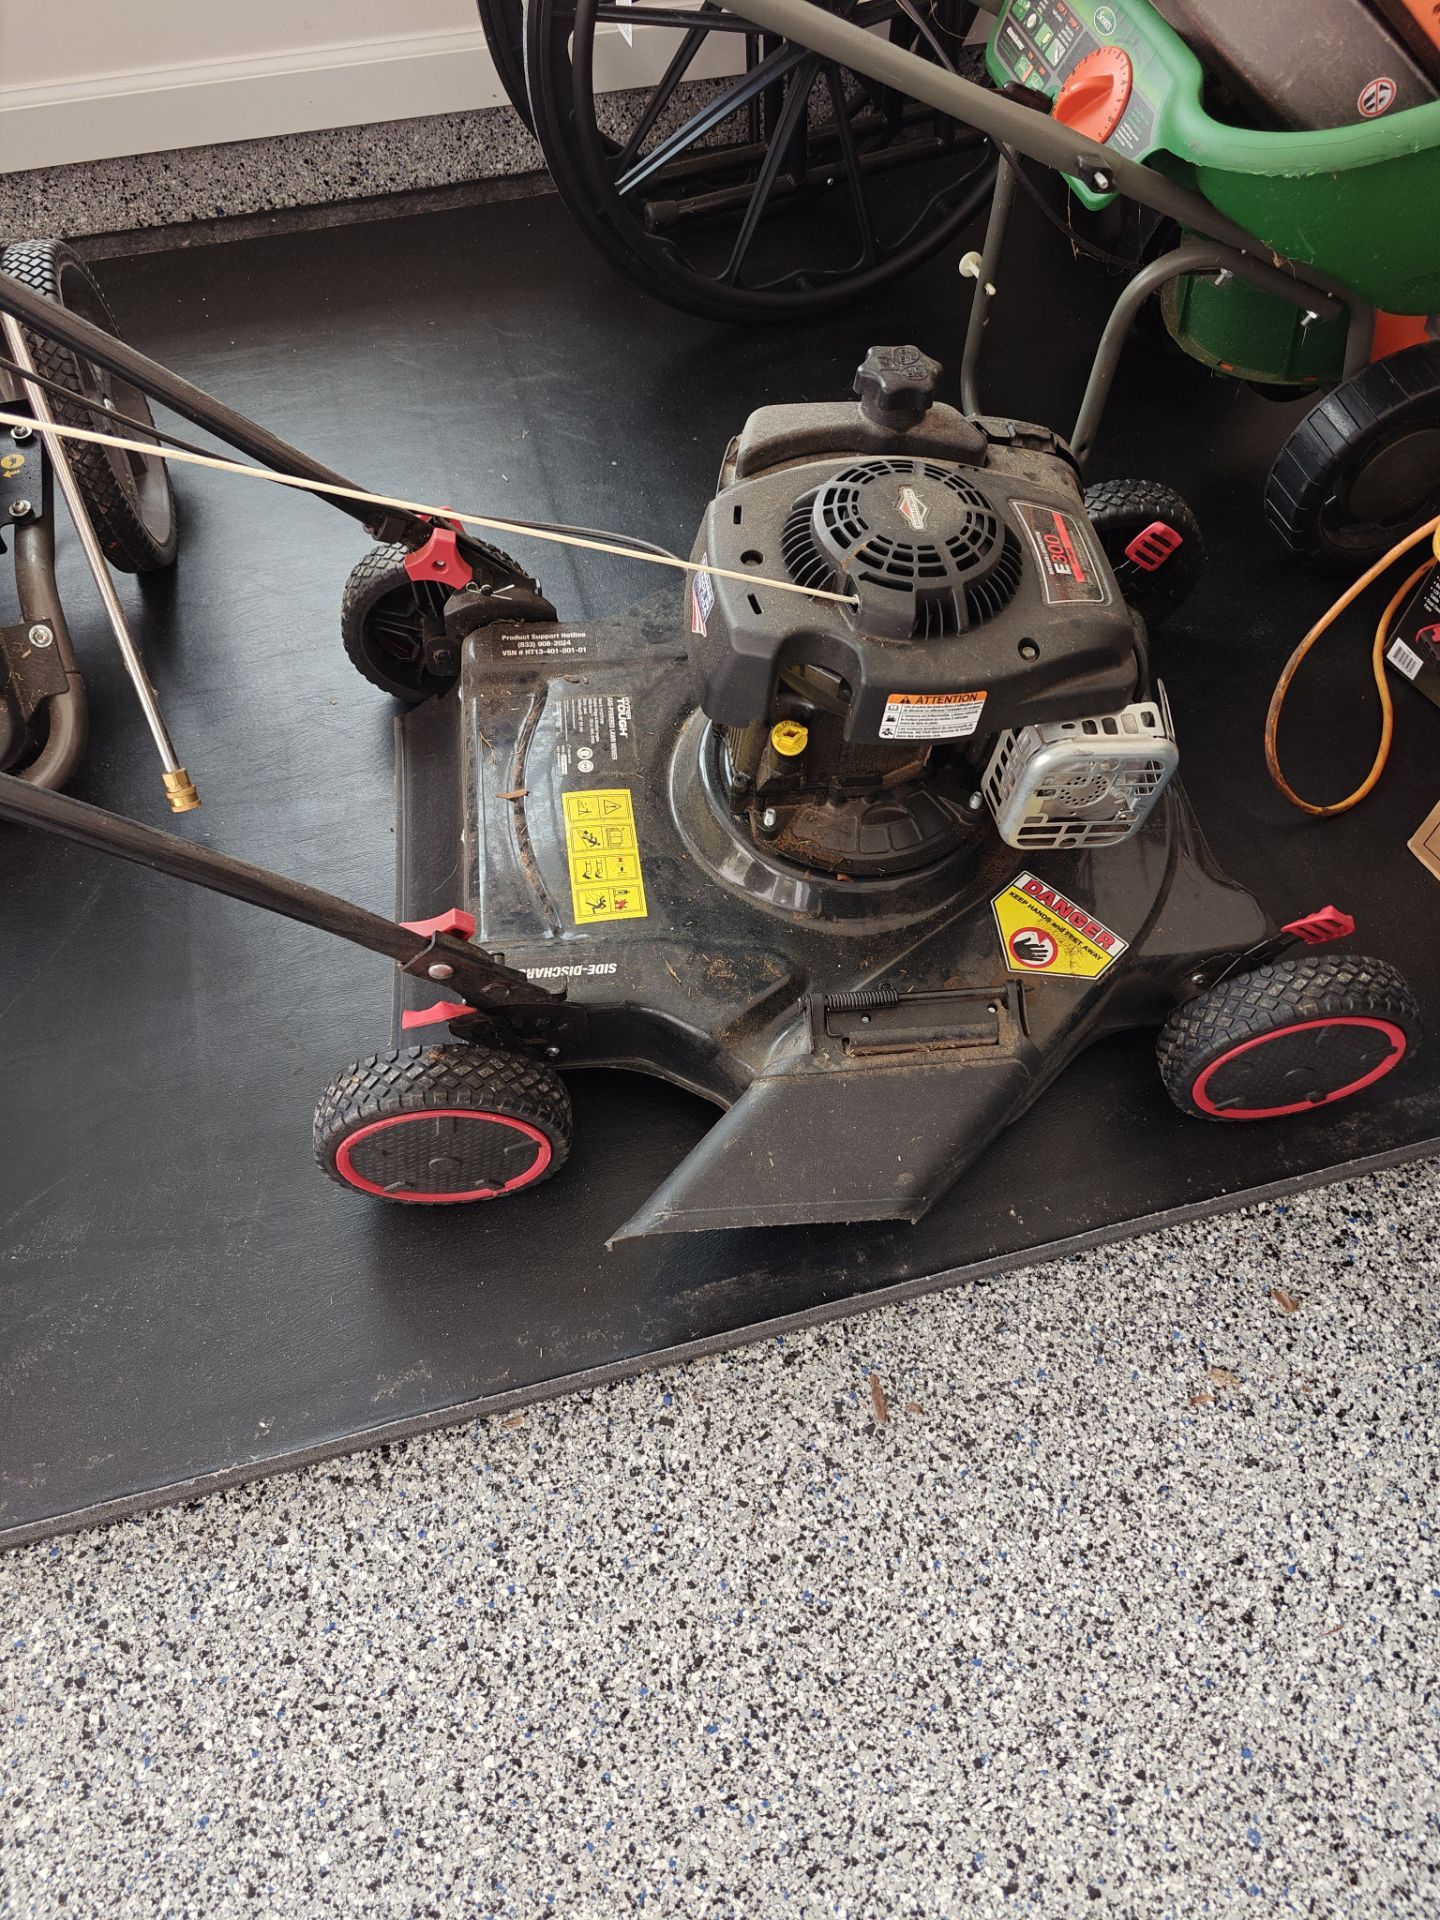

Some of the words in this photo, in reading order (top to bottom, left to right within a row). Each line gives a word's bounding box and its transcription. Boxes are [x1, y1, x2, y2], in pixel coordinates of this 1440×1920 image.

[1097, 10, 1112, 31] Scotts
[1043, 534, 1072, 576] E300
[525, 646, 587, 655] HT13-401-001-01
[537, 639, 571, 647] 908-2024
[624, 696, 632, 720] HYPER
[914, 693, 978, 704] ATTENTION
[617, 697, 628, 737] TOUGH
[1009, 891, 1029, 905] KEEP
[1027, 904, 1052, 923] HANDS
[1051, 922, 1066, 933] and
[1065, 930, 1084, 946] FEET
[1082, 945, 1103, 961] AWAY
[1022, 879, 1117, 951] DANGER
[518, 962, 618, 979] SIDE-DISCHAR
